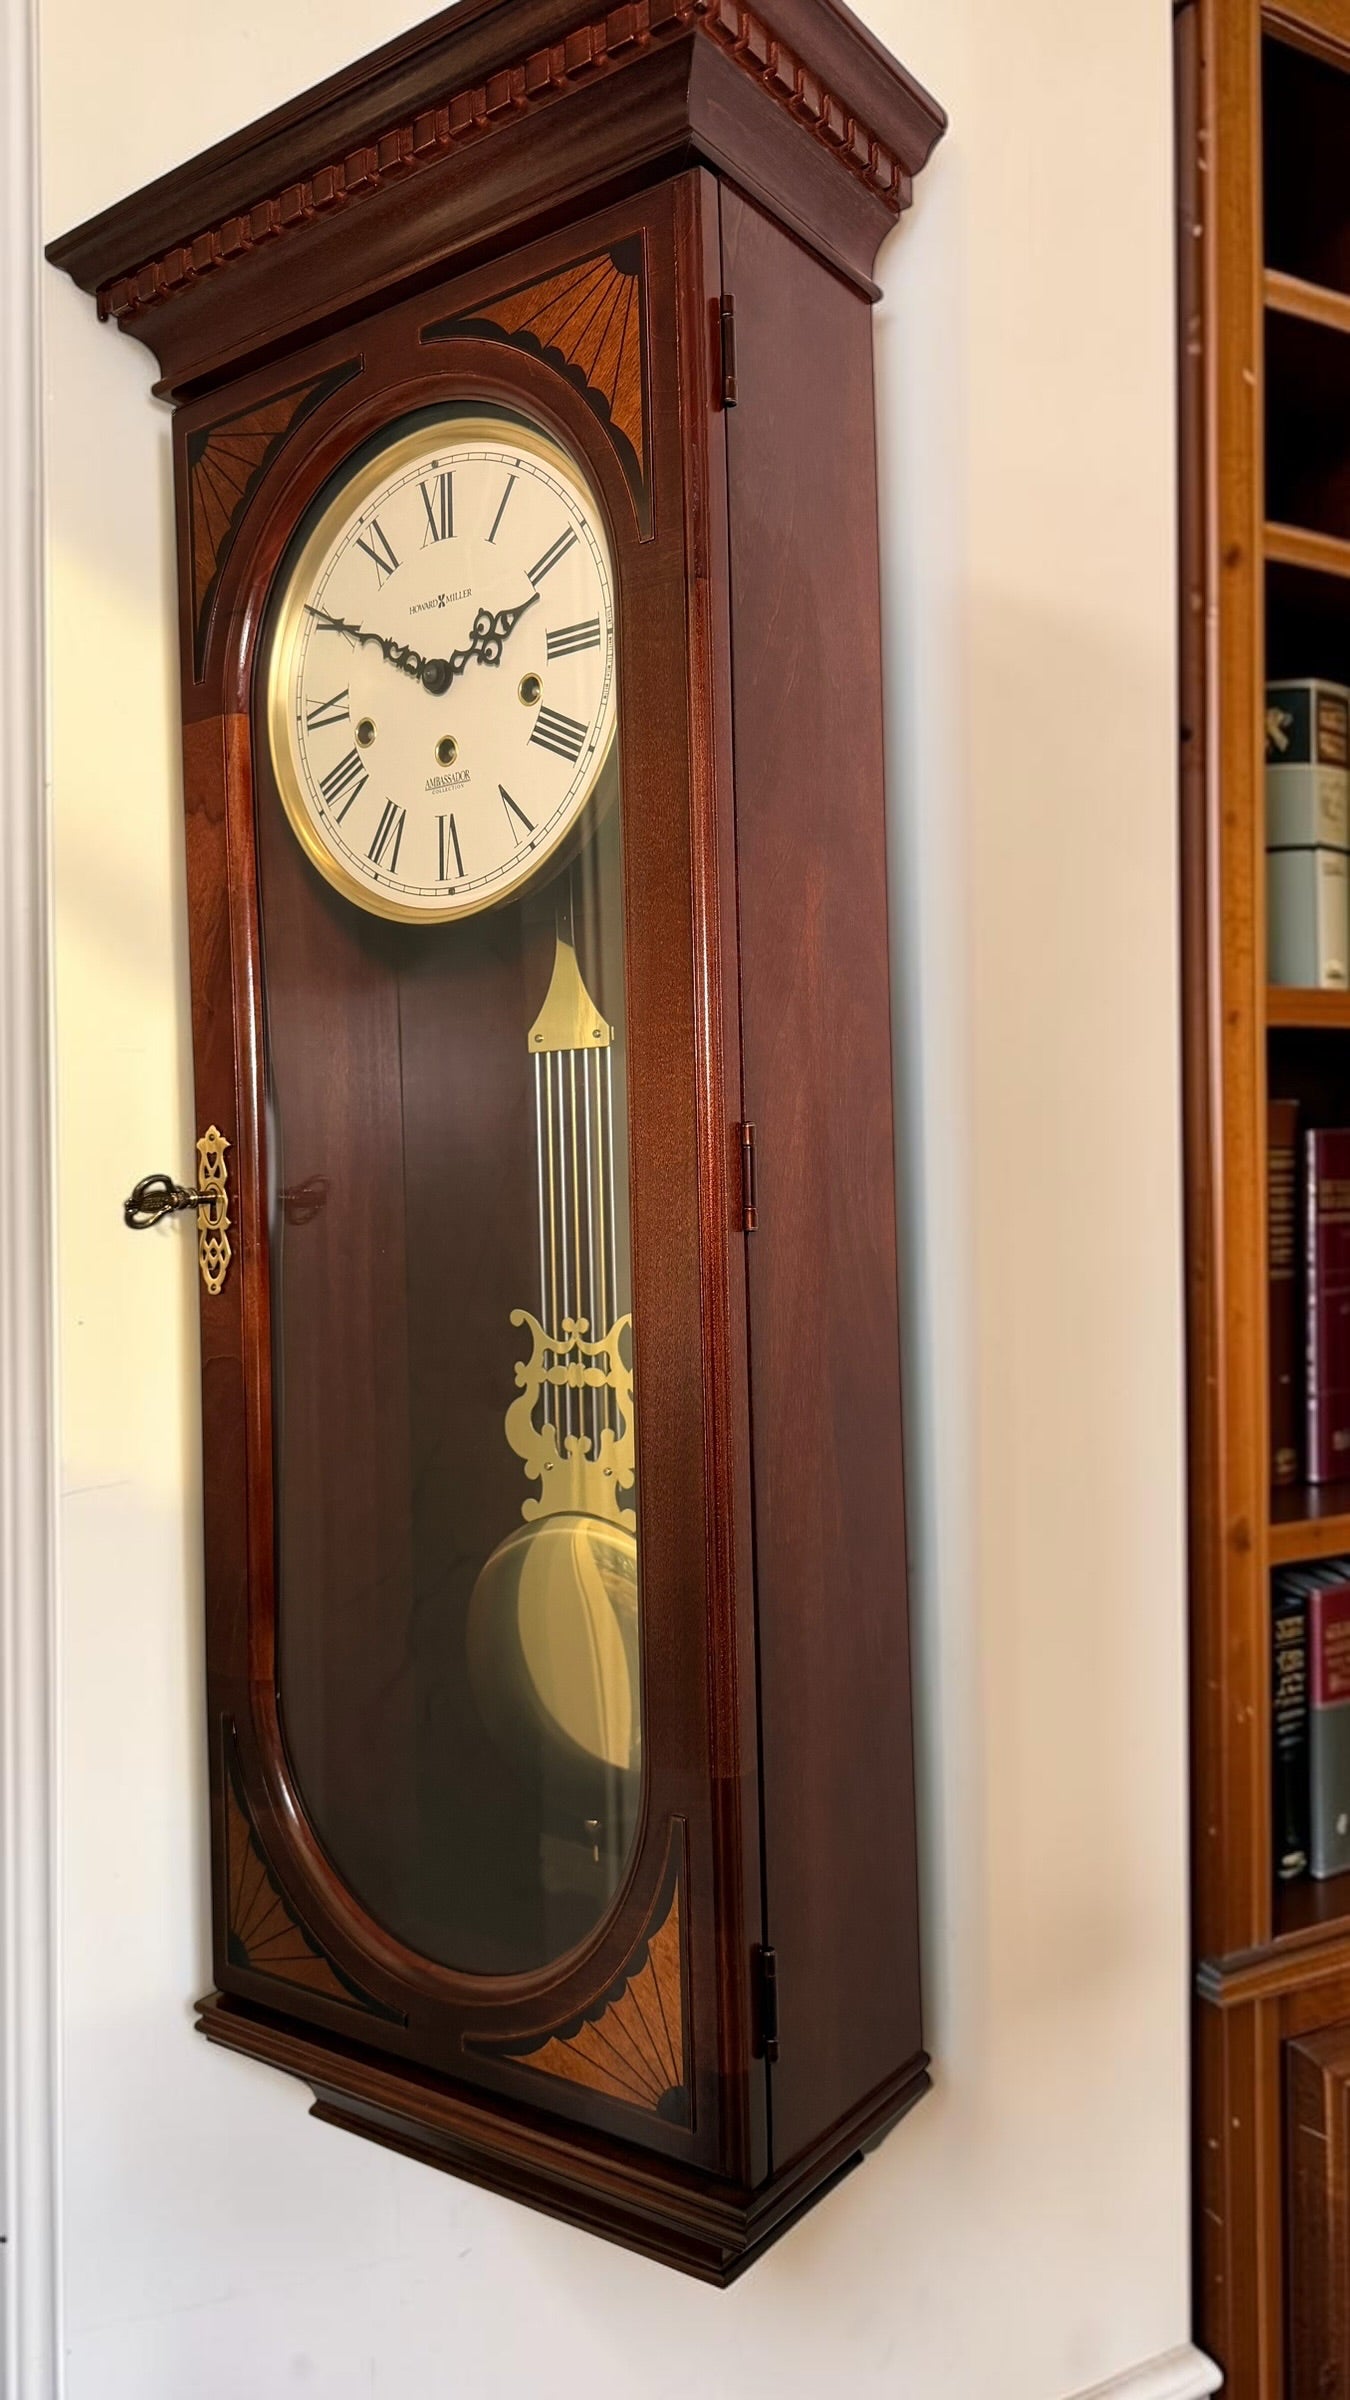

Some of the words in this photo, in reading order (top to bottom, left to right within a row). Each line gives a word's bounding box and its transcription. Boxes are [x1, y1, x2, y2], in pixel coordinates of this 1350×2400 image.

[416, 470, 458, 550] XII
[485, 473, 520, 545] I
[352, 515, 403, 591] XI
[524, 521, 580, 592] II
[409, 599, 438, 615] HOWARD
[446, 588, 472, 604] MILLER
[545, 611, 601, 667] III
[305, 682, 351, 737] IX
[527, 699, 590, 768] IIII
[317, 742, 369, 828] VIII
[424, 769, 471, 791] AMBASSADOR
[431, 783, 465, 795] COLLECTION
[364, 795, 407, 875] VII
[435, 813, 468, 882] VI
[498, 784, 539, 849] V
